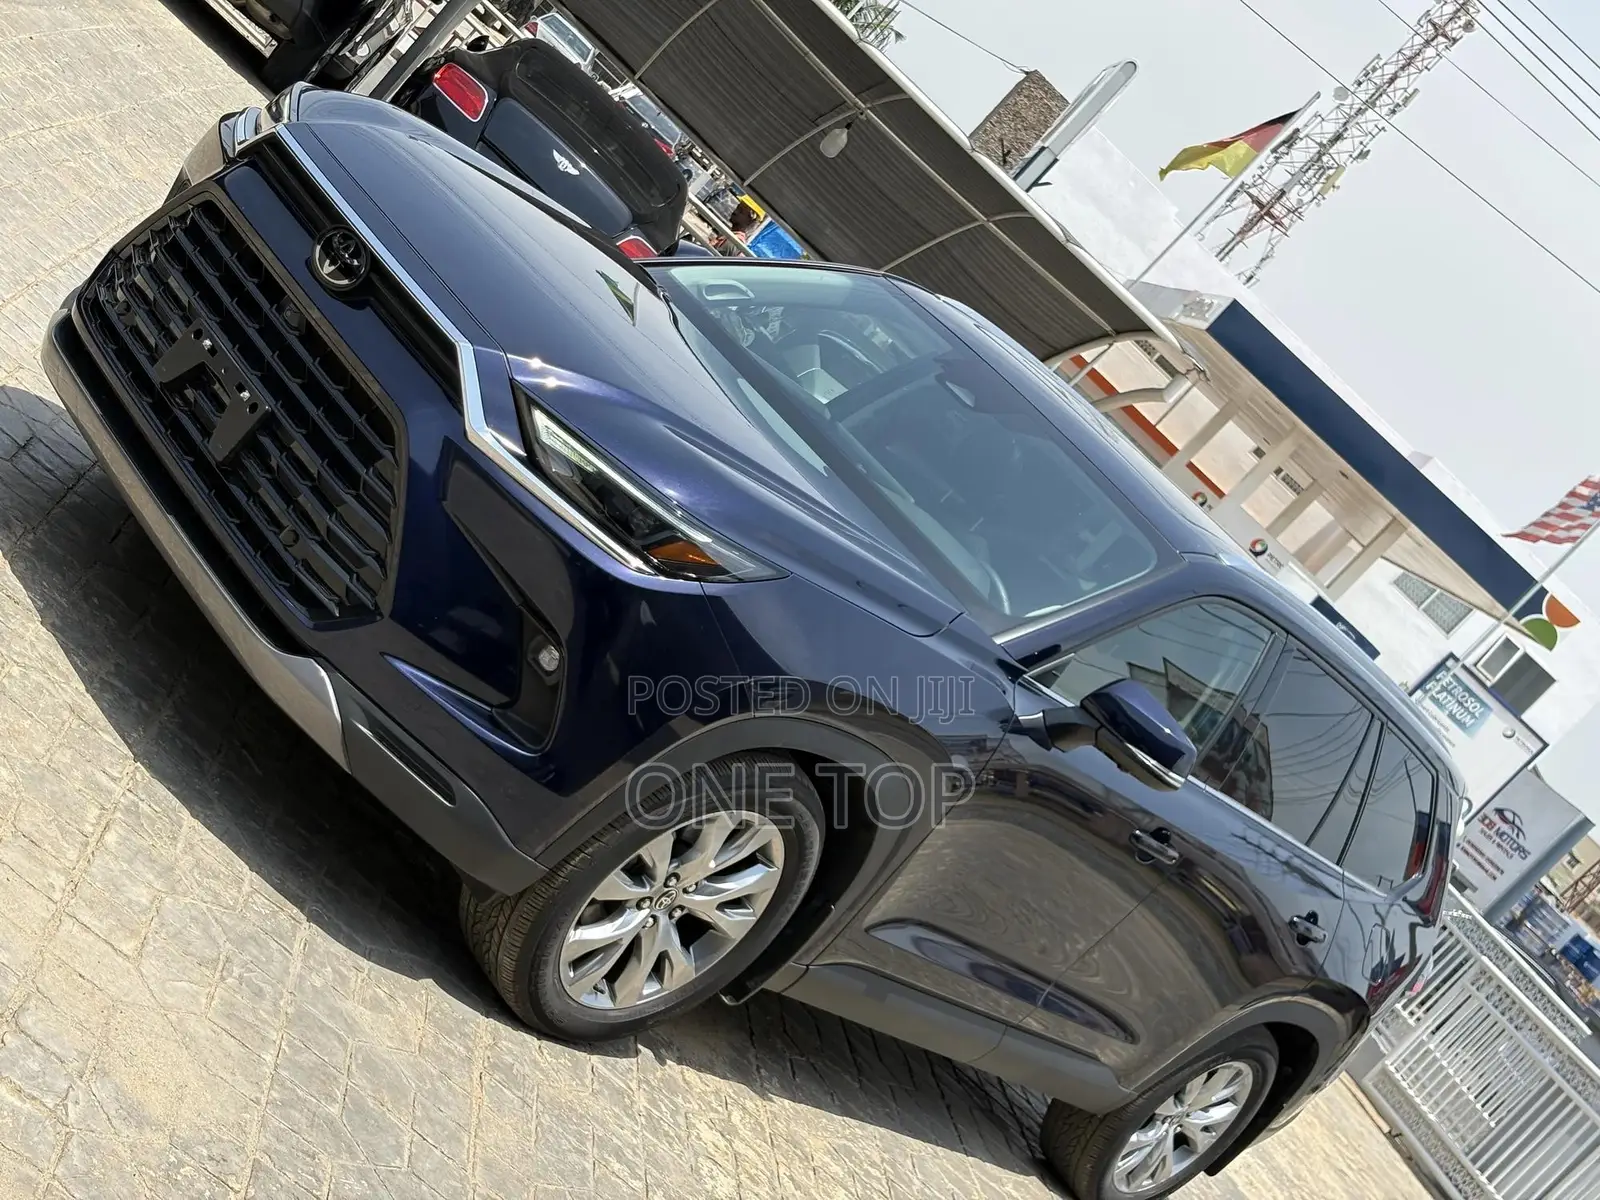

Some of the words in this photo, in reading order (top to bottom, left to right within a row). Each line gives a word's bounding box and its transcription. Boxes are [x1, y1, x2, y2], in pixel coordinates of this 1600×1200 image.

[1426, 681, 1476, 728] PLATINUM
[1435, 670, 1486, 718] PETROSOL
[1495, 826, 1531, 860] MOTORS
